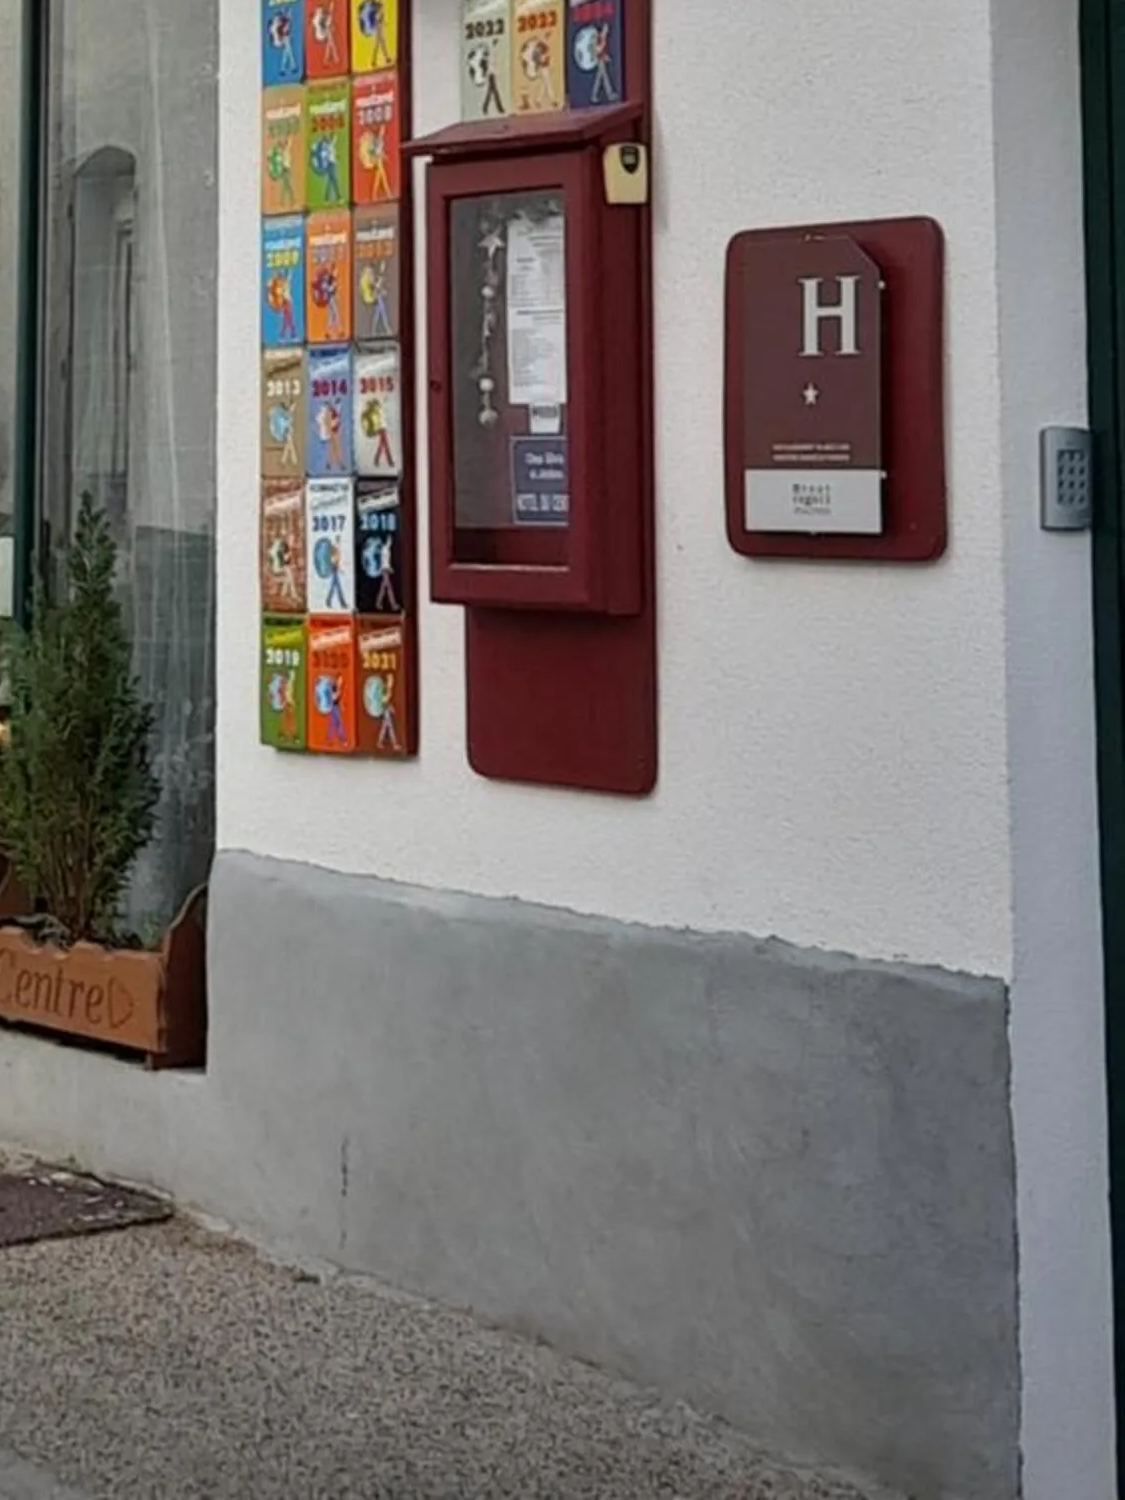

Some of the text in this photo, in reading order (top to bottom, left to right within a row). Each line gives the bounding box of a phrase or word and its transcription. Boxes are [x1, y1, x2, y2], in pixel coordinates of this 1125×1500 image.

[797, 275, 861, 356] H
[267, 379, 301, 397] 2013
[359, 376, 394, 394] 2015
[312, 514, 346, 533] 2017
